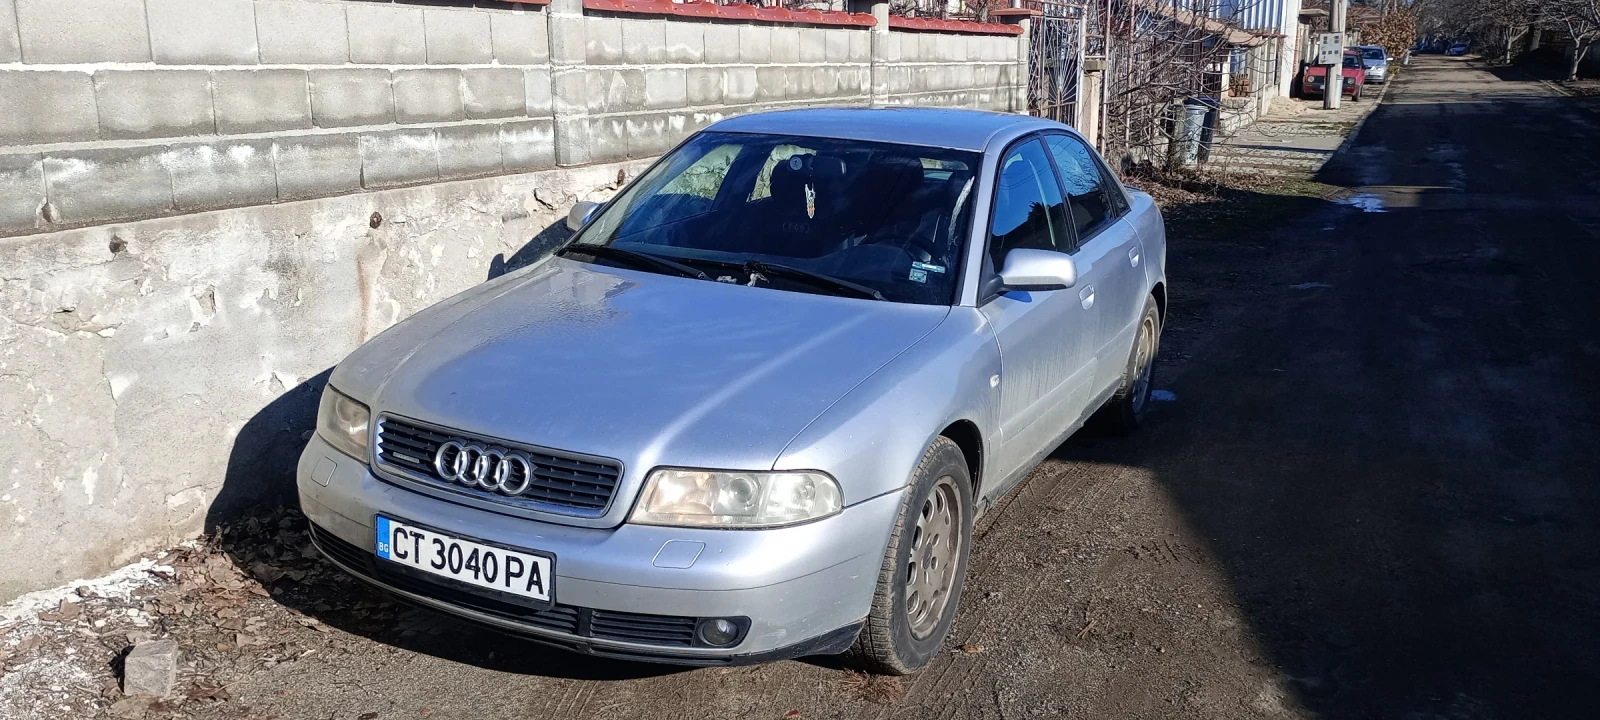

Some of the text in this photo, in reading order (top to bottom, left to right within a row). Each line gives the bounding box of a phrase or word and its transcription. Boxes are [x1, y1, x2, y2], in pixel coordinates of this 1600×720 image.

[378, 541, 389, 553] BG
[393, 527, 544, 595] CT 3040 PA
